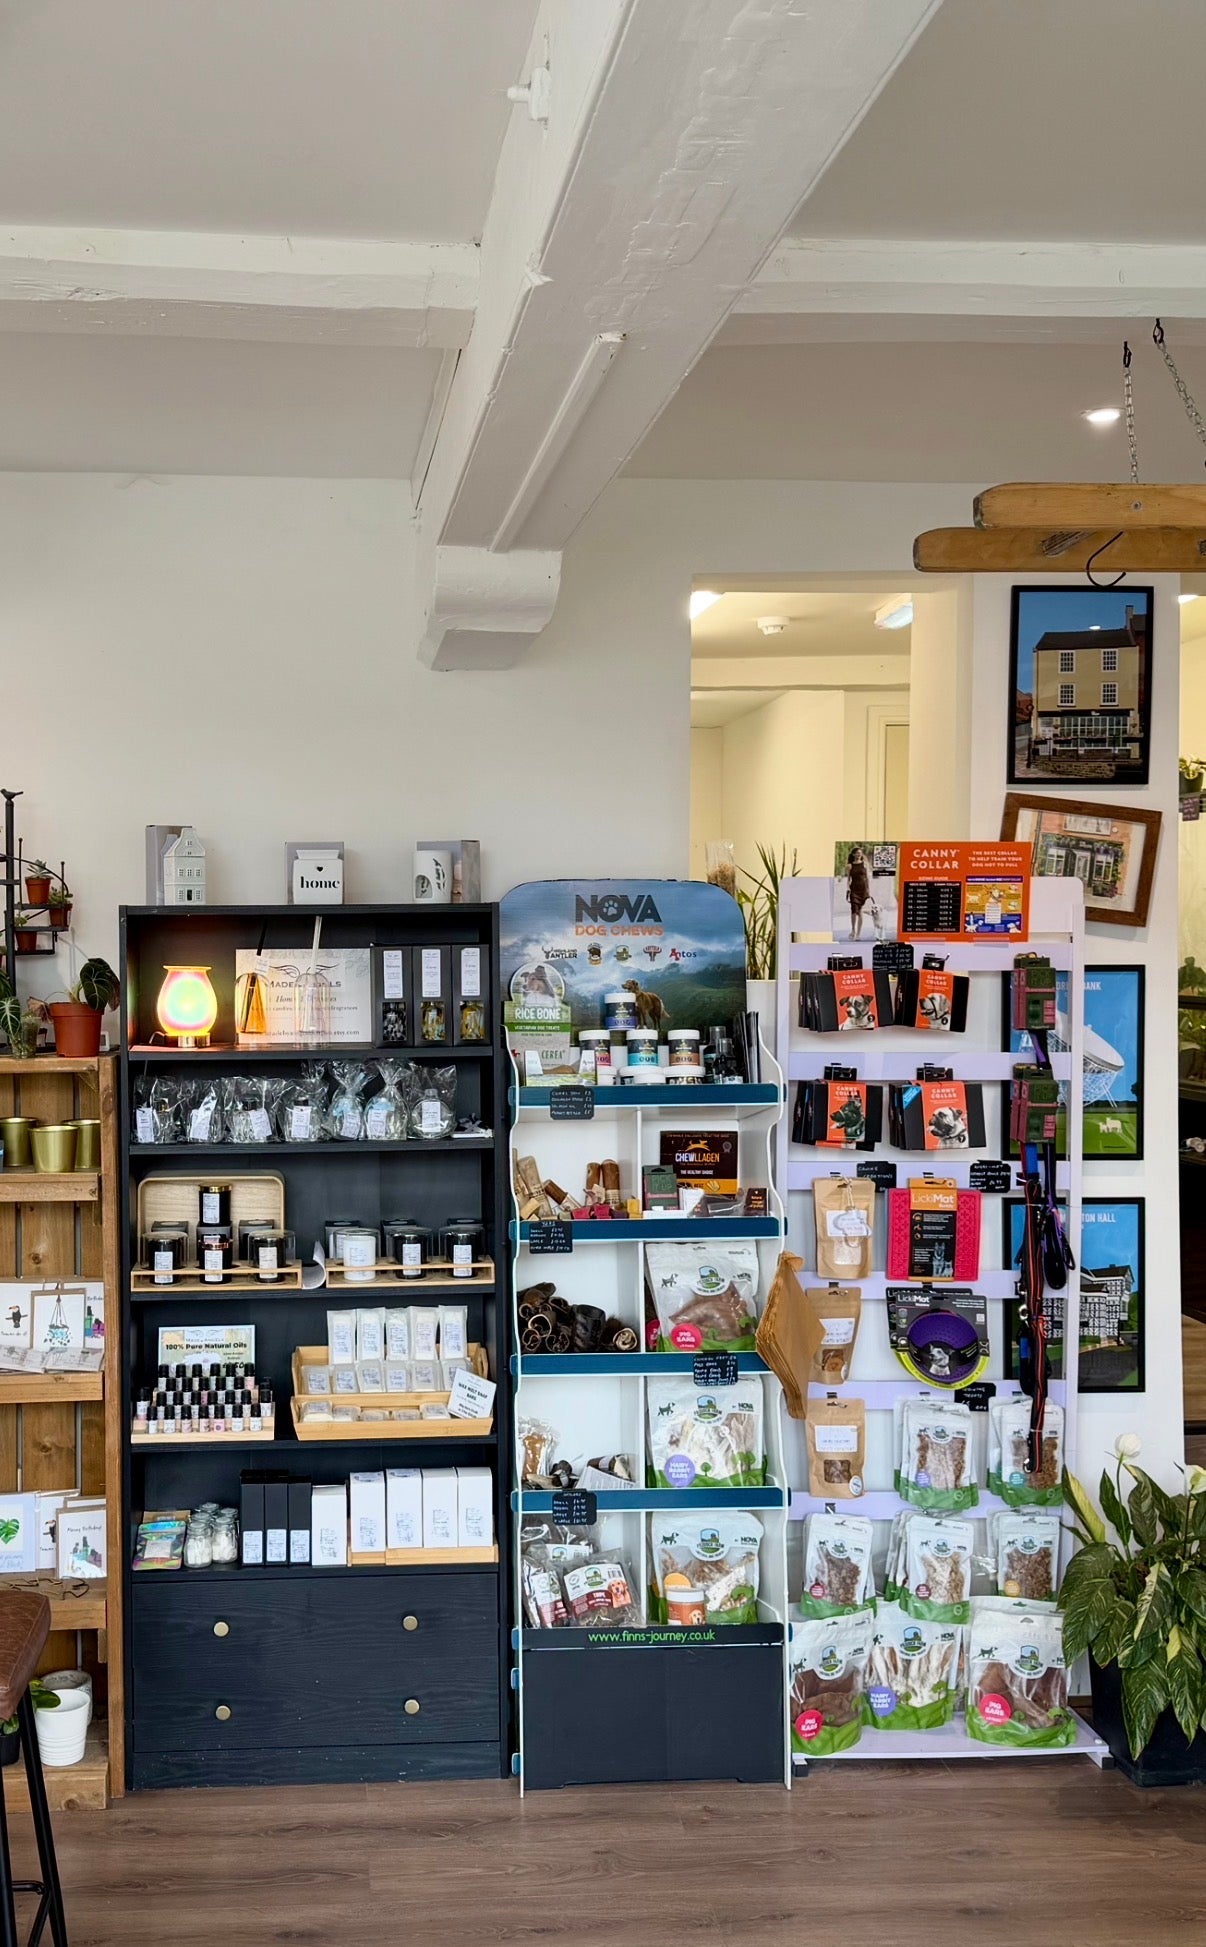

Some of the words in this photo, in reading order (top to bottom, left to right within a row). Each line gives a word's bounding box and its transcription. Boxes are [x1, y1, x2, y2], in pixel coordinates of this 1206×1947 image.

[913, 849, 958, 858] CANNY
[910, 860, 959, 869] COLLAR
[300, 876, 340, 888] home
[576, 894, 662, 922] NOVA
[576, 925, 607, 936] DOG
[610, 925, 664, 936] CHEWS
[515, 1008, 536, 1020] RICE
[537, 1008, 561, 1020] BONE
[675, 1152, 719, 1162] CHEWLLAGEN
[912, 1194, 954, 1204] LickiMat
[1097, 1213, 1116, 1222] HALL
[897, 1295, 930, 1303] LickiMat
[588, 1629, 715, 1644] www.finns-journey.co.uk
[985, 1708, 1005, 1716] EARS
